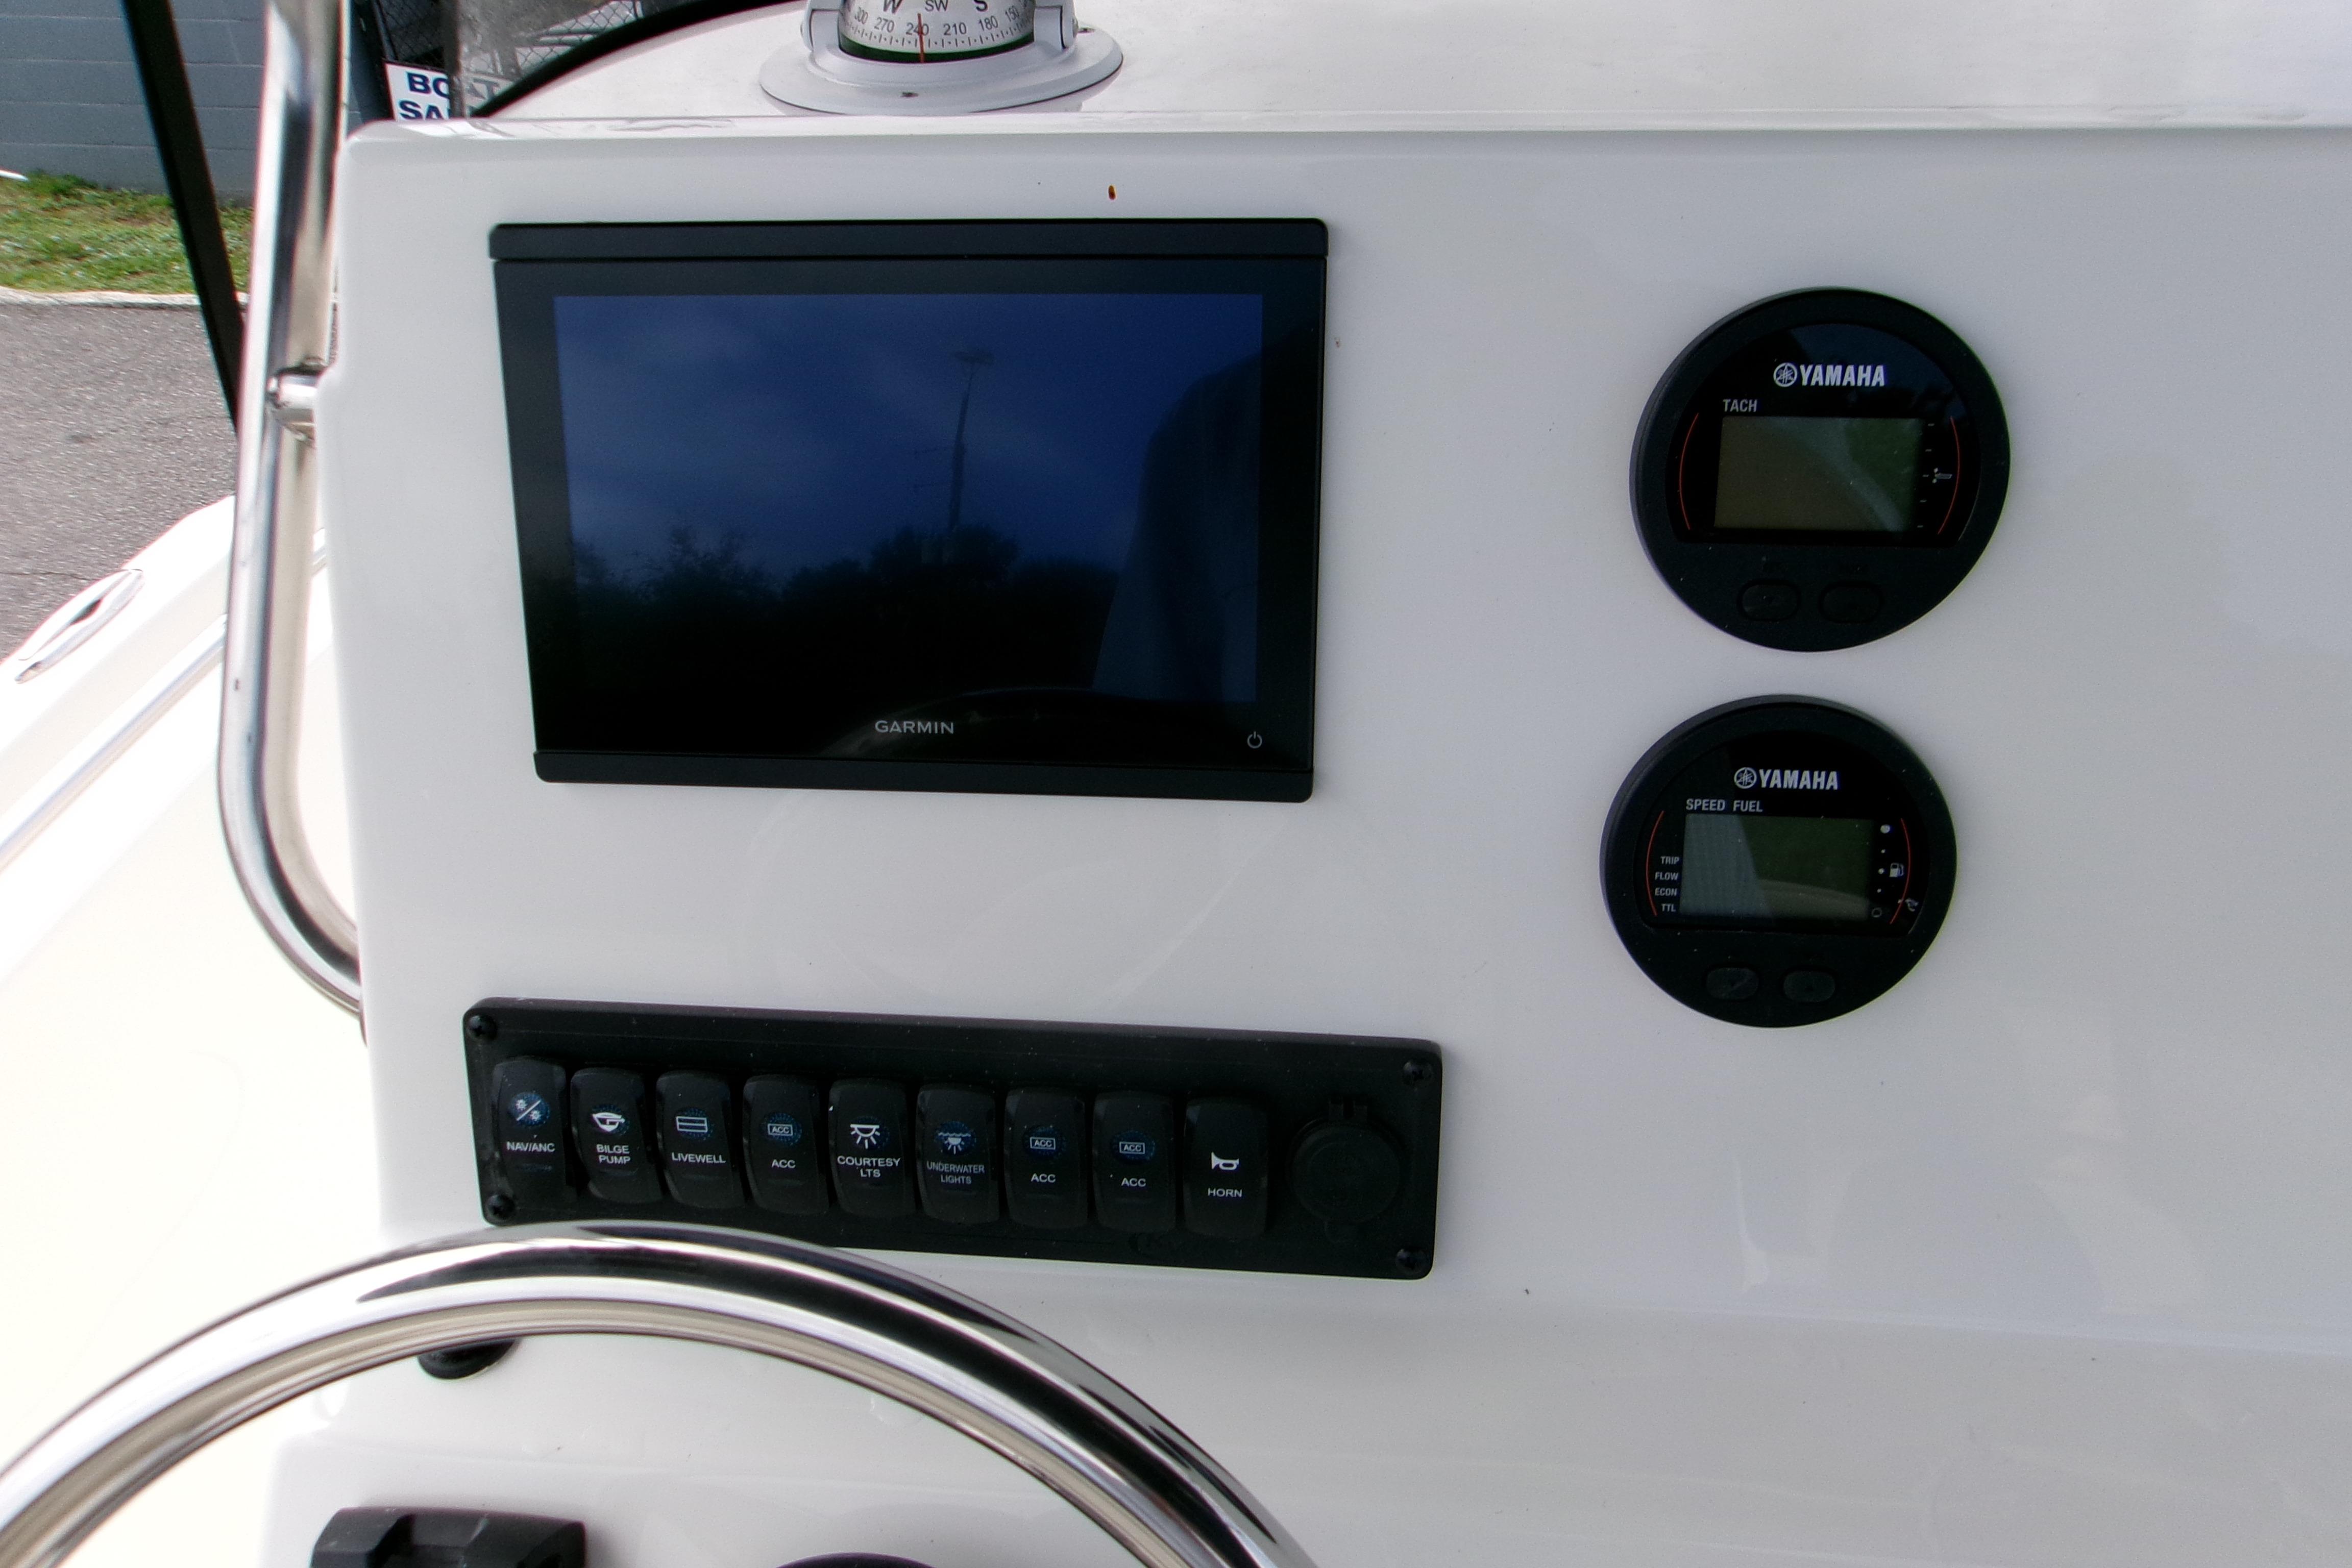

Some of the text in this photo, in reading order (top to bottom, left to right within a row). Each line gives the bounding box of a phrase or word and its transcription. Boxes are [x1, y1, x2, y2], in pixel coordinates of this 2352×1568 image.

[874, 17, 894, 33] 270
[905, 22, 929, 36] 240
[944, 23, 966, 36] 210
[978, 16, 998, 33] 180
[1799, 364, 1885, 387] YAMAHA
[1722, 399, 1757, 412] TACH
[875, 720, 954, 734] GARMIN
[1759, 769, 1838, 790] YAMAHA
[1685, 798, 1763, 813] SPEED FUEL
[1660, 855, 1680, 865] TRIP
[1654, 871, 1679, 881] FLOW
[1654, 887, 1677, 897] ECON
[1661, 903, 1677, 913] TTL
[771, 1125, 790, 1134] ACC
[506, 1141, 555, 1153] NAV/ANC
[1034, 1139, 1052, 1147] ACC
[1123, 1144, 1142, 1152] ACC
[596, 1144, 630, 1154] BILGE
[598, 1156, 631, 1164] PUMP
[671, 1152, 726, 1164] LIVEWELL
[837, 1156, 901, 1167] COURTESY
[771, 1159, 796, 1169] ACC
[926, 1160, 985, 1174] UNDERWATER
[860, 1169, 881, 1178] LTS
[1031, 1173, 1056, 1183] ACC
[940, 1174, 972, 1185] LIGHTS
[1121, 1178, 1146, 1187] ACC
[1207, 1187, 1242, 1197] HORN
